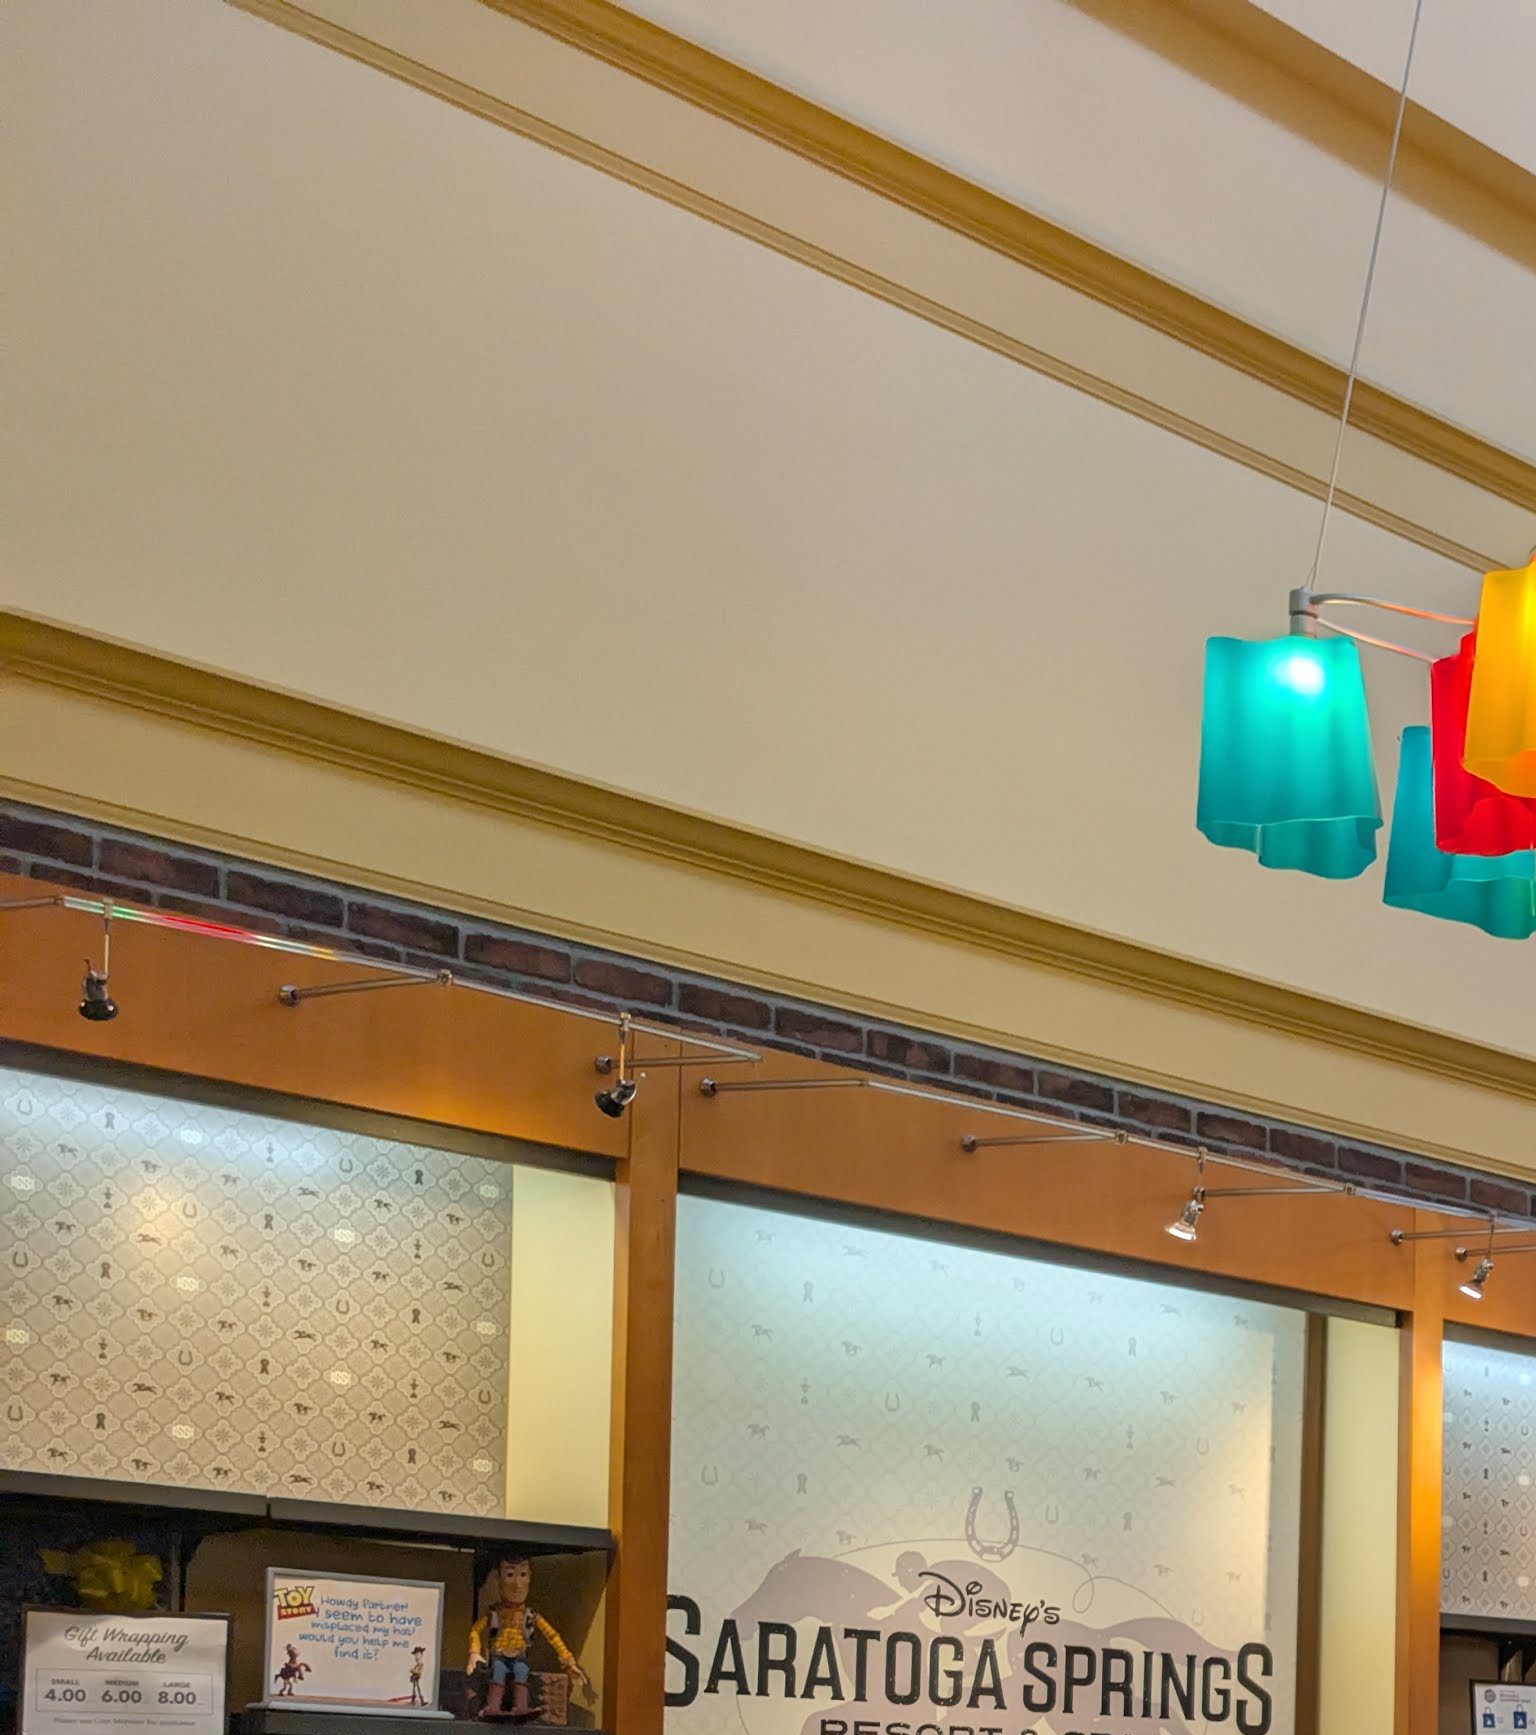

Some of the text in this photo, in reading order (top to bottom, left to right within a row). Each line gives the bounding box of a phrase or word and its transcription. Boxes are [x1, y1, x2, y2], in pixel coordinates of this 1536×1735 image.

[273, 1586, 314, 1607] TOY
[320, 1595, 358, 1610] Howdy
[279, 1606, 312, 1616] STORY
[325, 1610, 363, 1621] seem
[368, 1612, 384, 1623] to
[389, 1613, 422, 1626] have
[311, 1621, 369, 1634] misplaced
[373, 1627, 389, 1636] my
[64, 1625, 189, 1652] Gift Wrapping
[298, 1632, 409, 1648] would you help me
[86, 1646, 167, 1664] Available
[334, 1646, 379, 1661] find it?
[664, 1594, 1007, 1710] SARATOGA
[51, 1678, 80, 1686] SMALL
[44, 1688, 196, 1705] 4.00 6.00 8.00
